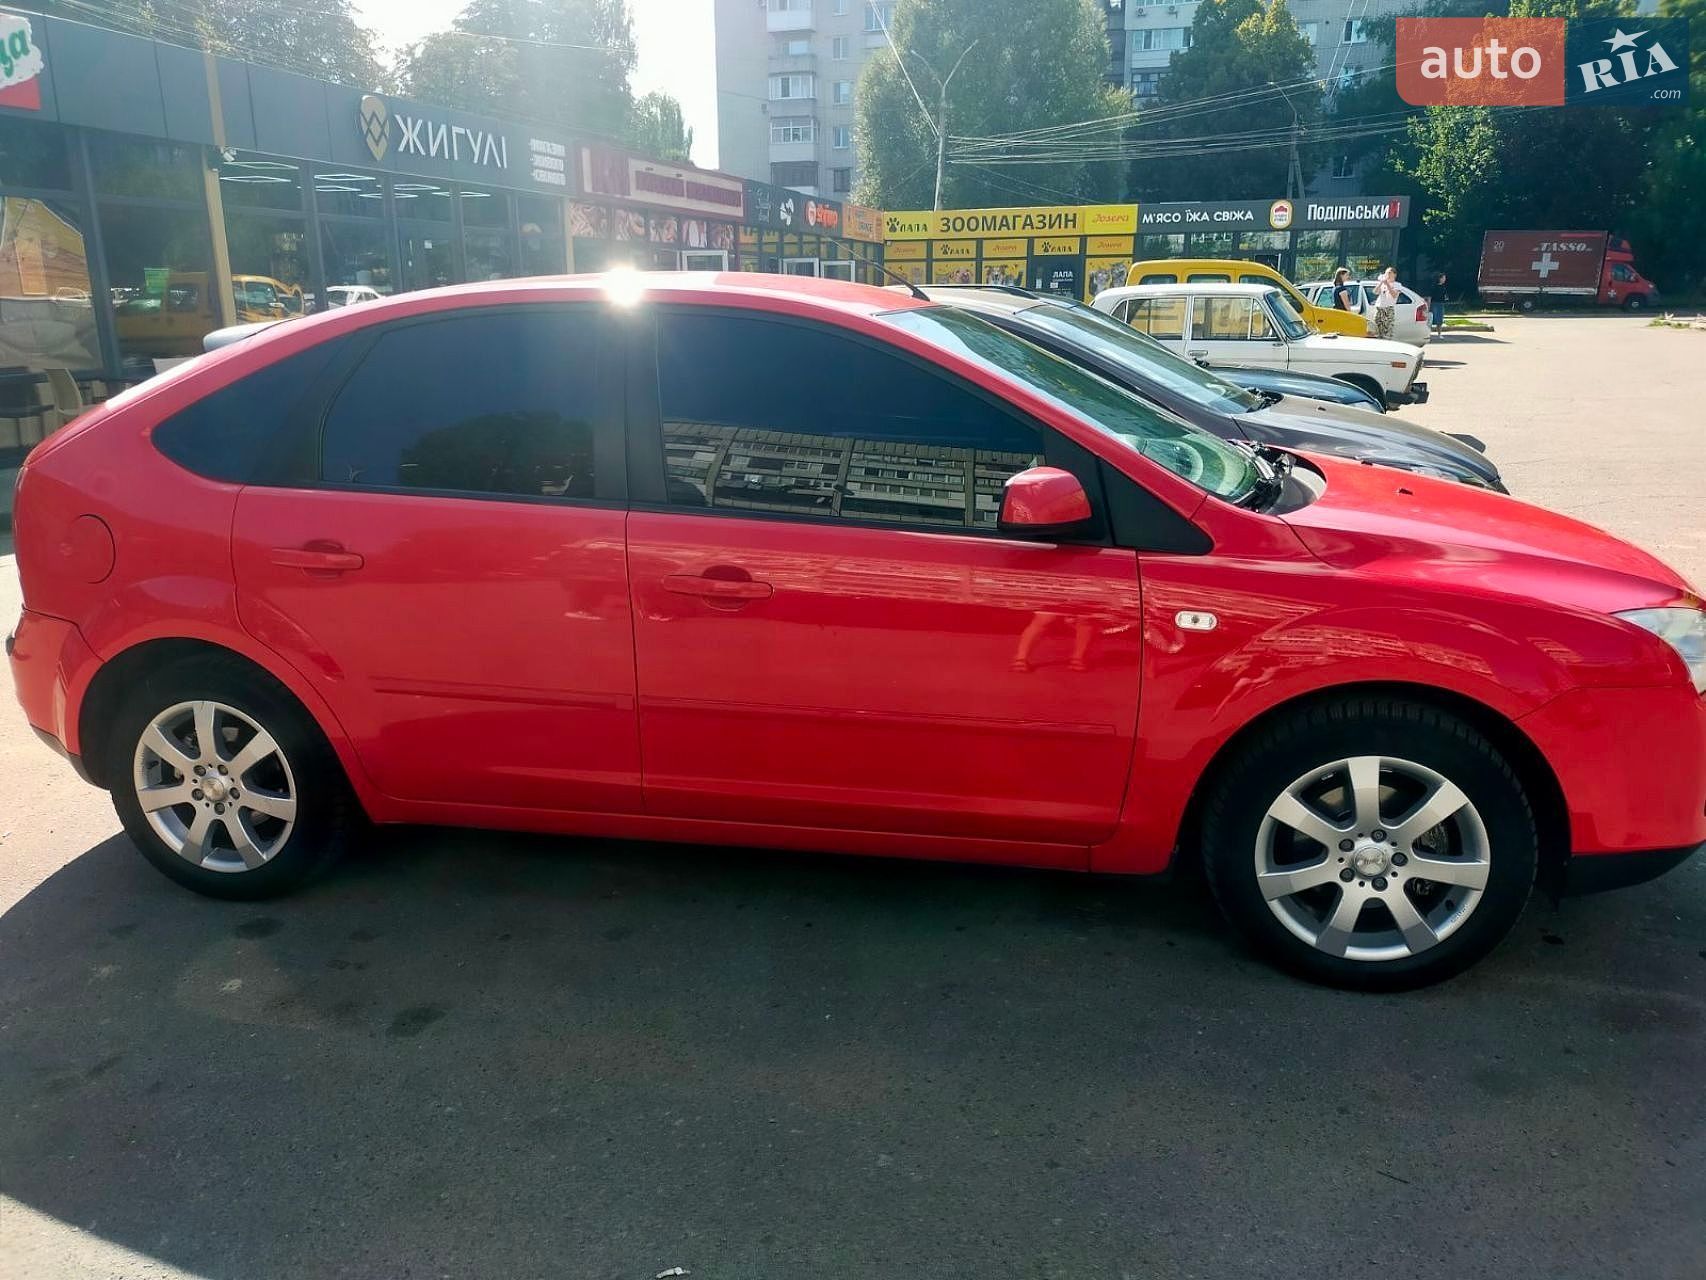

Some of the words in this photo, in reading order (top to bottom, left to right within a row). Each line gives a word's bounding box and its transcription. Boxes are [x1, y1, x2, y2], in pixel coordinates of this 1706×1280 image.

[393, 114, 508, 169] ЖИГУЛІ
[939, 212, 1078, 233] ЗООМАГАЗИН
[1142, 212, 1182, 224] М'ЯСО
[1185, 208, 1210, 222] ЇЖА
[1213, 209, 1254, 222] СВІЖА
